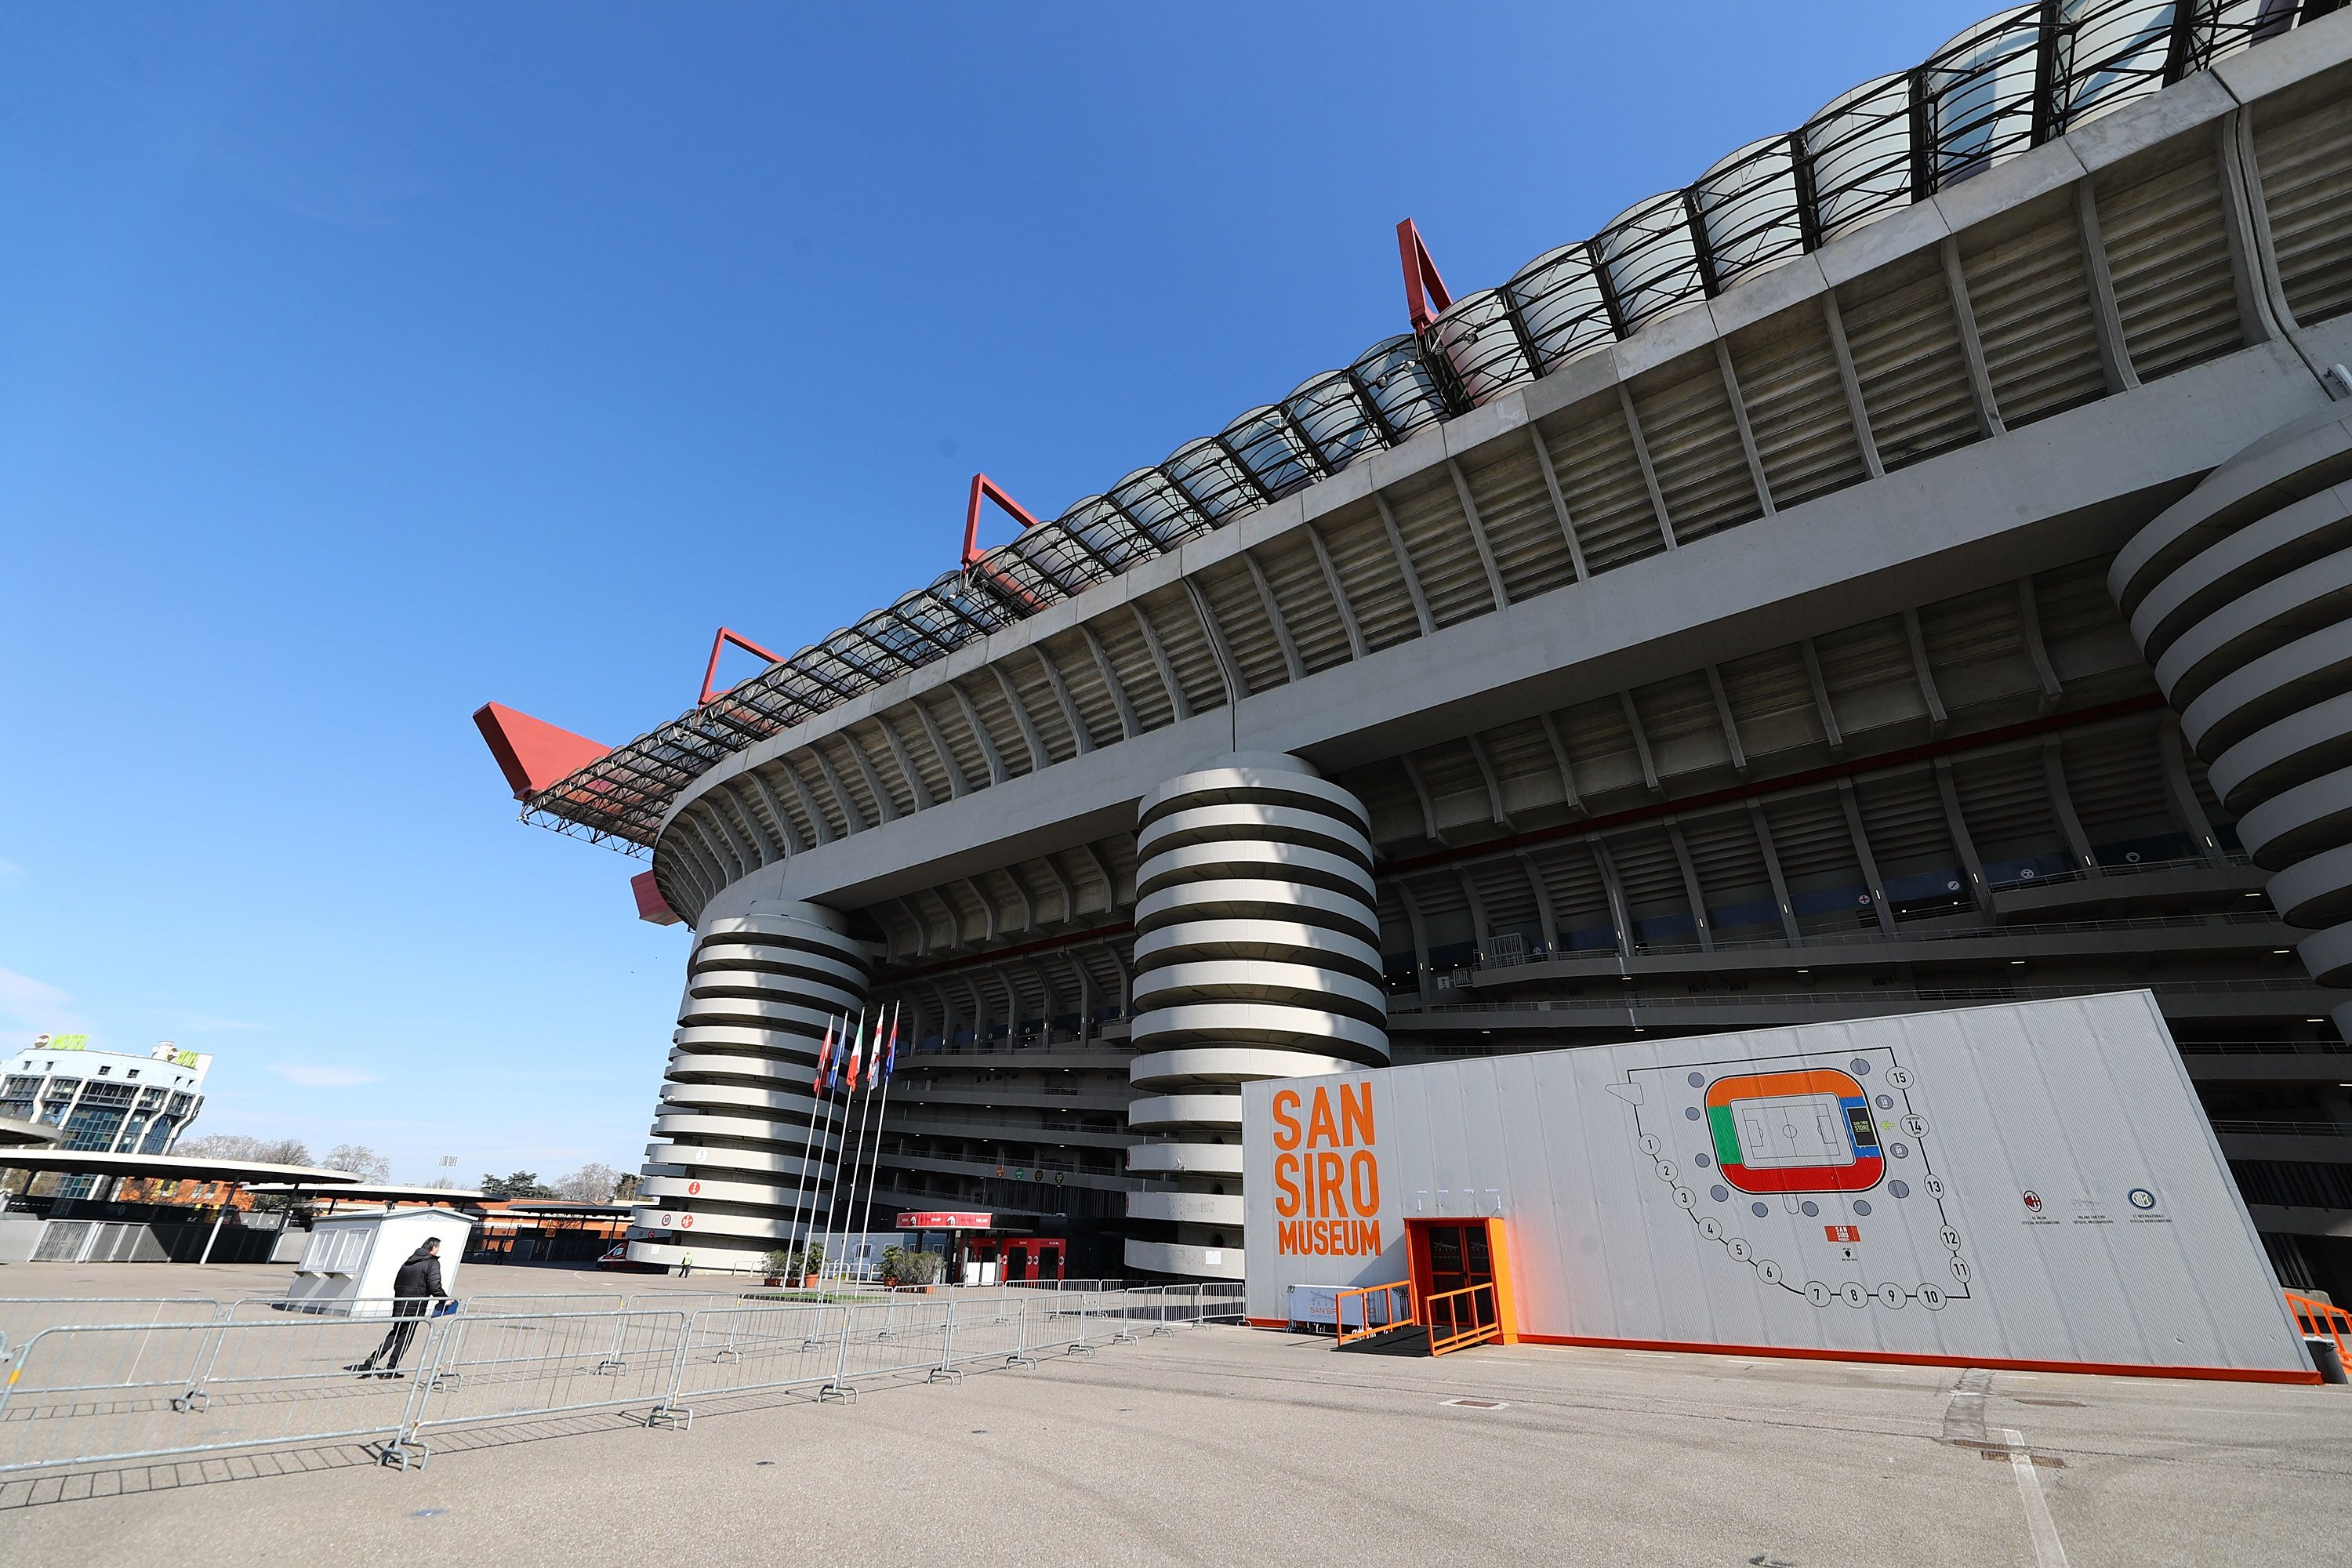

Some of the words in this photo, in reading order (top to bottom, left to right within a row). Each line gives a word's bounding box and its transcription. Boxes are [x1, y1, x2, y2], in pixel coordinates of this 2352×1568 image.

[50, 1034, 89, 1050] HOTEL
[1893, 1072, 1907, 1083] 15
[1272, 1082, 1375, 1151] SAN
[1907, 1120, 1922, 1132] 14
[1647, 1139, 1653, 1149] 1
[1663, 1165, 1670, 1176] 2
[1275, 1150, 1380, 1218] SIRO
[1927, 1181, 1941, 1192] 13
[1681, 1192, 1688, 1203] 3
[1708, 1223, 1715, 1234] 4
[1279, 1220, 1381, 1256] MUSEUM
[1943, 1232, 1958, 1244] 12
[1736, 1244, 1743, 1256] 5
[1766, 1266, 1773, 1278] 6
[1953, 1263, 1967, 1276] 11
[1813, 1288, 1820, 1301] 7
[1850, 1289, 1858, 1301] 8
[1888, 1290, 1895, 1302] 9
[1923, 1290, 1939, 1304] 10
